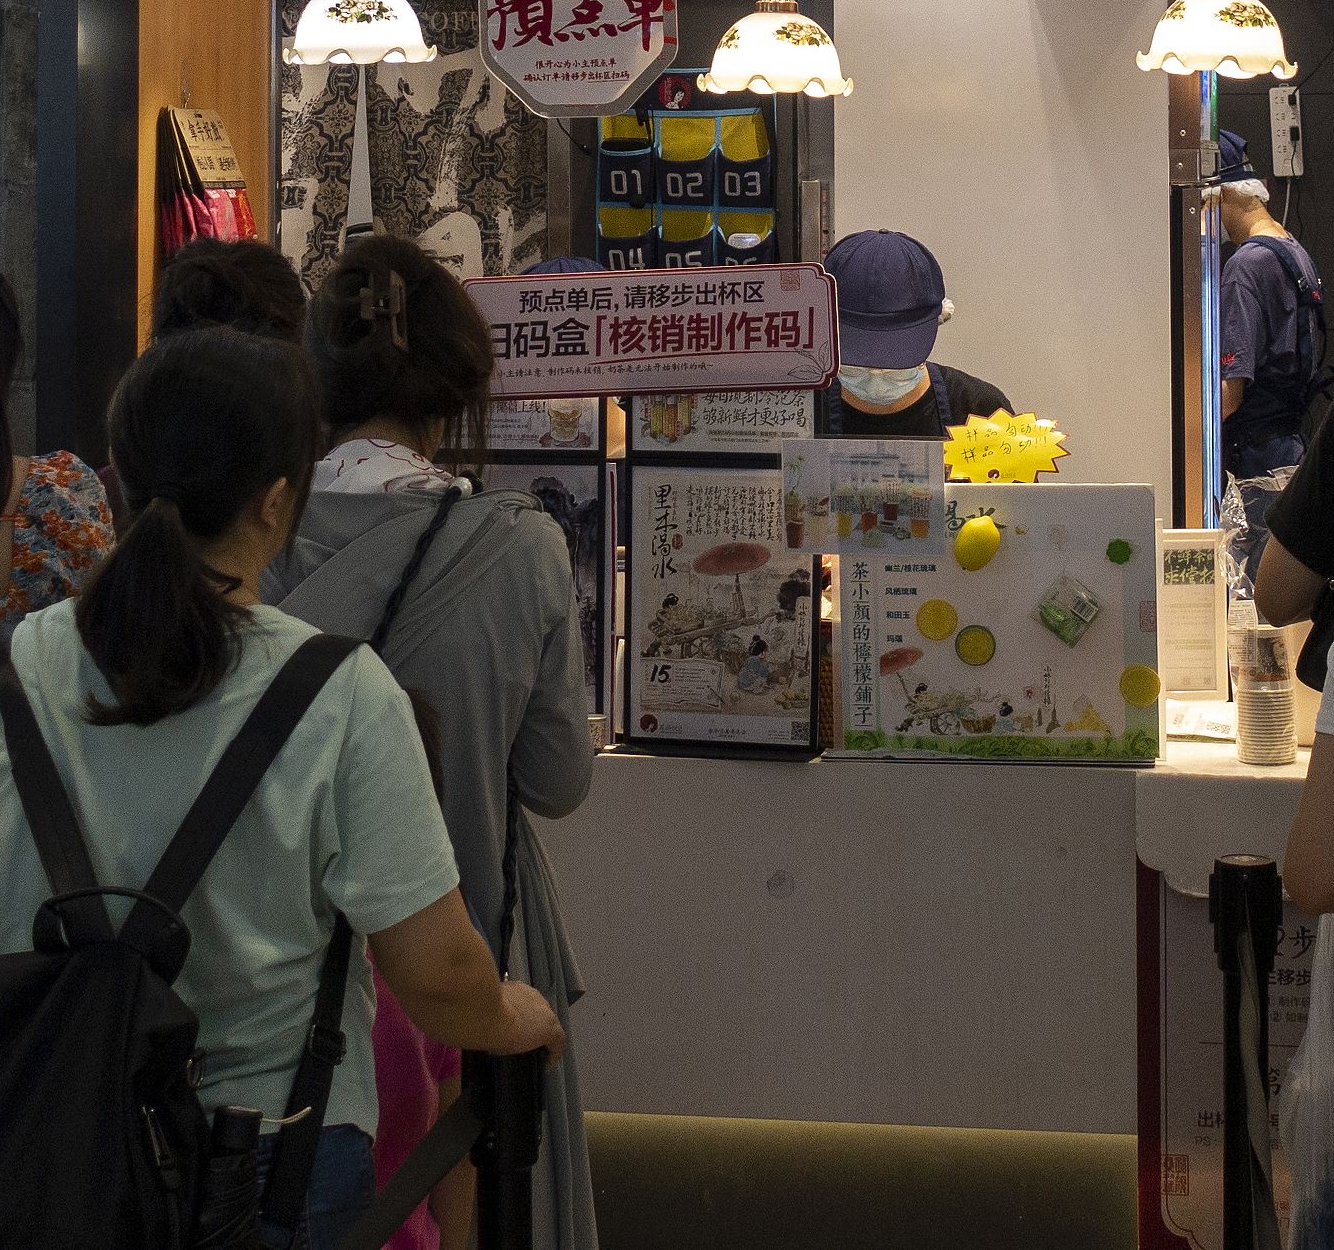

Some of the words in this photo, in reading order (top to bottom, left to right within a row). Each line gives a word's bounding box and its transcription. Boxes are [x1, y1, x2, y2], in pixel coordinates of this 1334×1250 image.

[610, 169, 643, 195] 01
[667, 172, 703, 197] 02
[725, 171, 761, 196] 03
[608, 247, 646, 270] 04
[703, 407, 806, 427] 够新鲜才更好喝
[650, 664, 671, 684] 15
